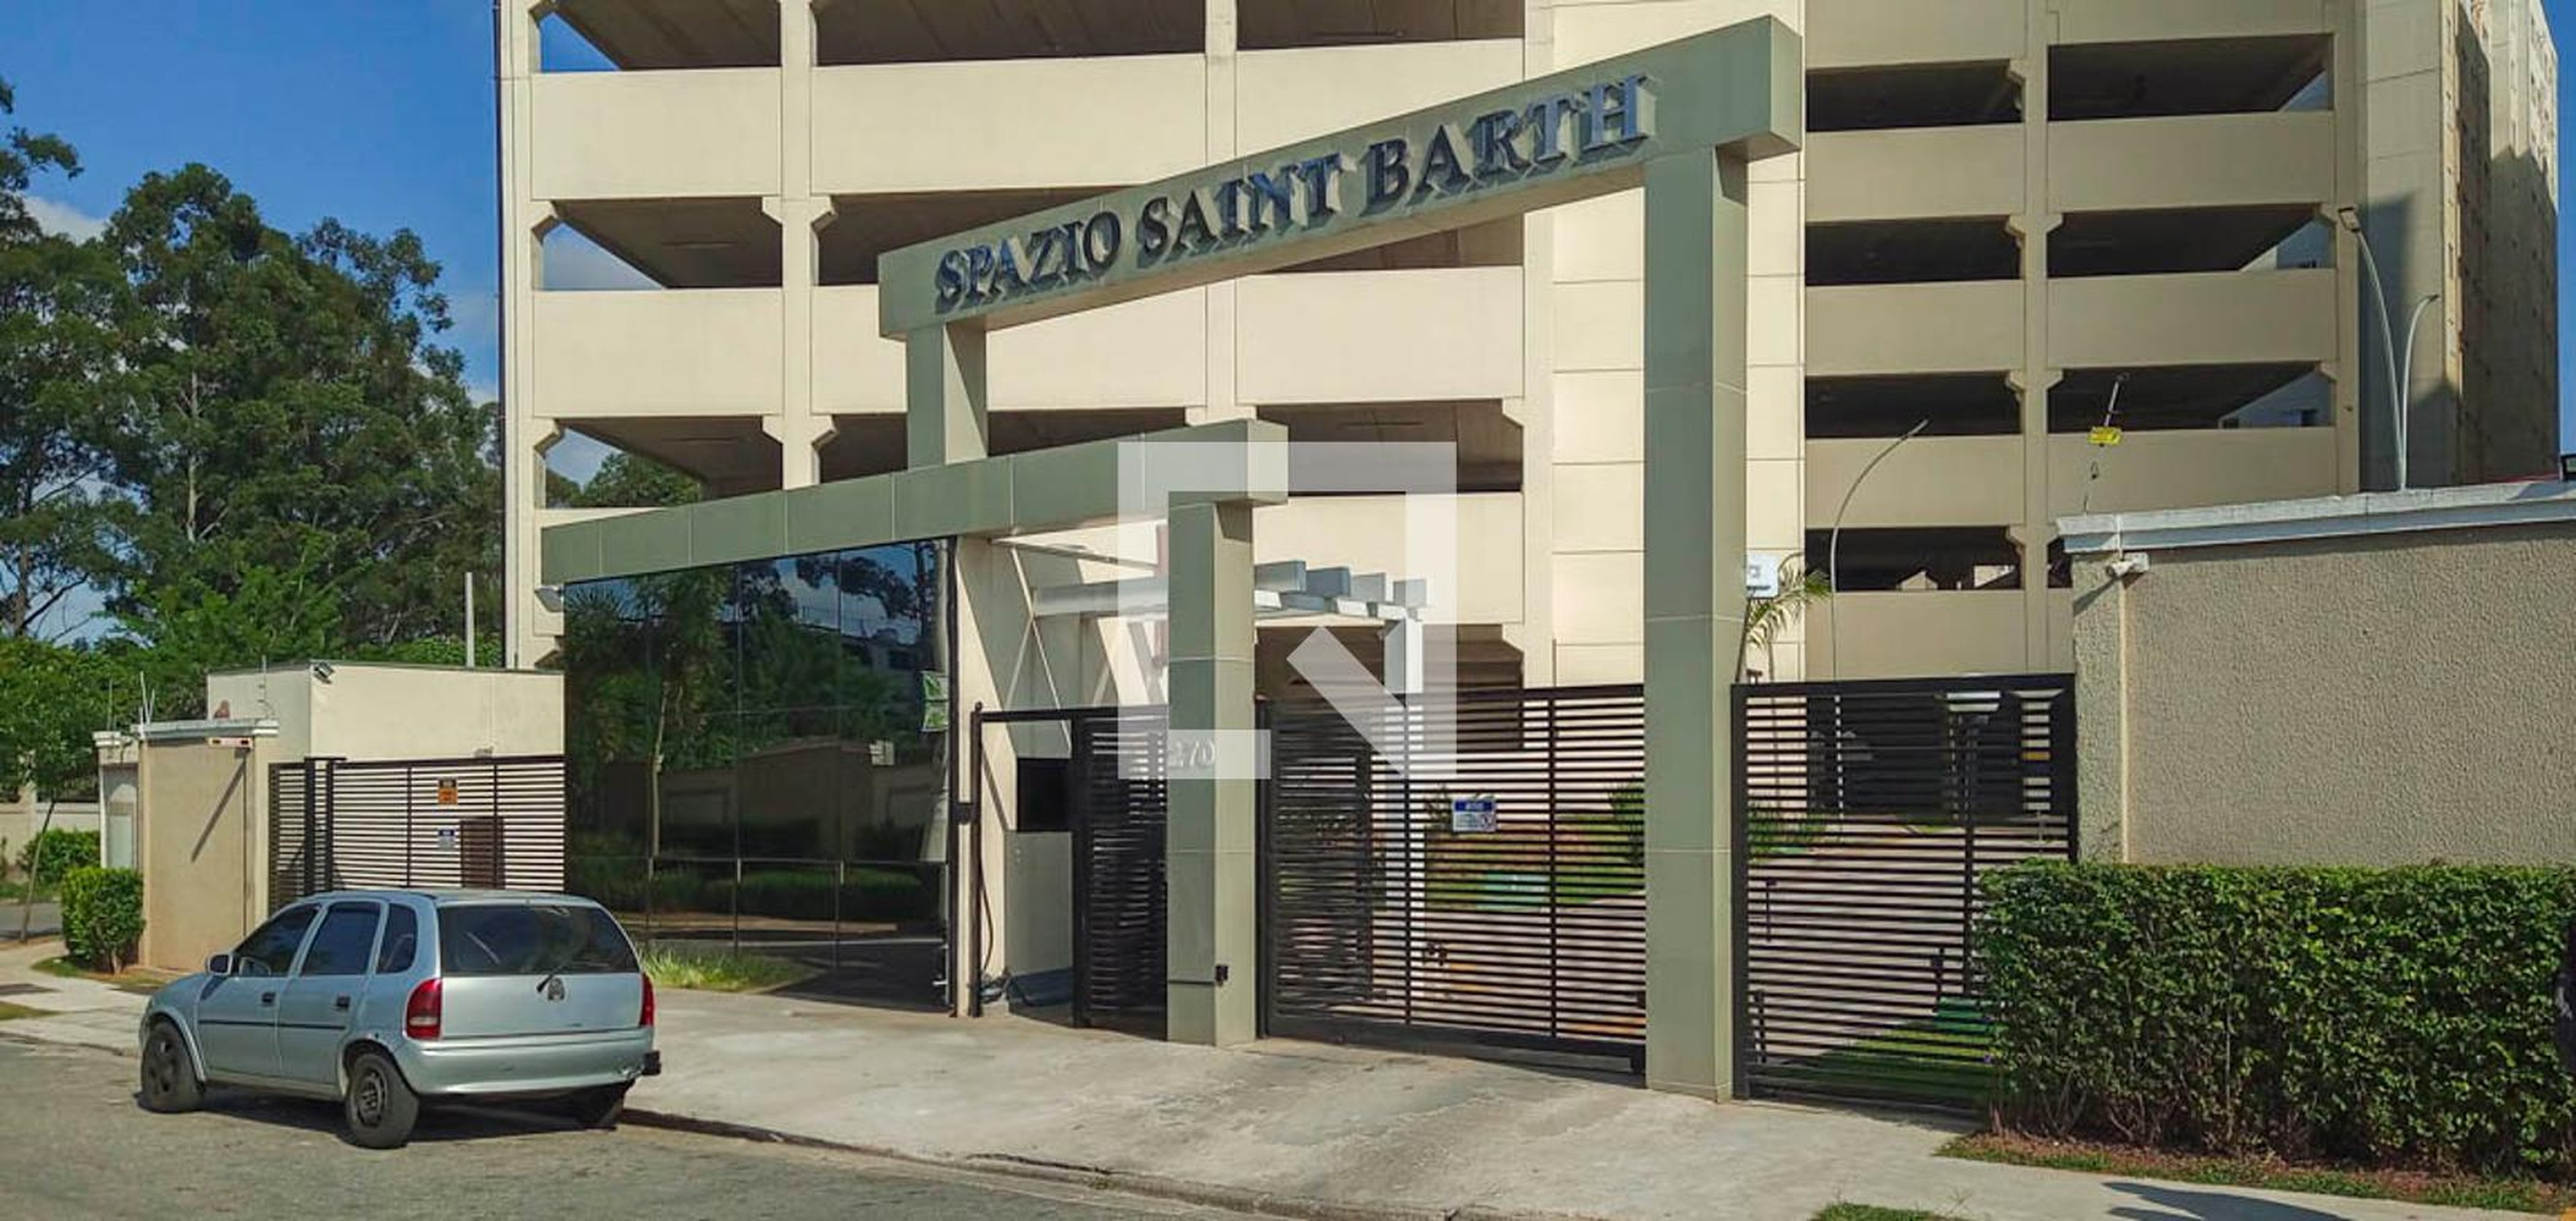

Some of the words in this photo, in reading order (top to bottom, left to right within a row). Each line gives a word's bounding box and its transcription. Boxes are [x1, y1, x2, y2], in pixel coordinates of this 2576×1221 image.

[936, 210, 1122, 305] SPAZIO
[1139, 152, 1344, 255] SAINT
[1366, 74, 1648, 204] BARTH
